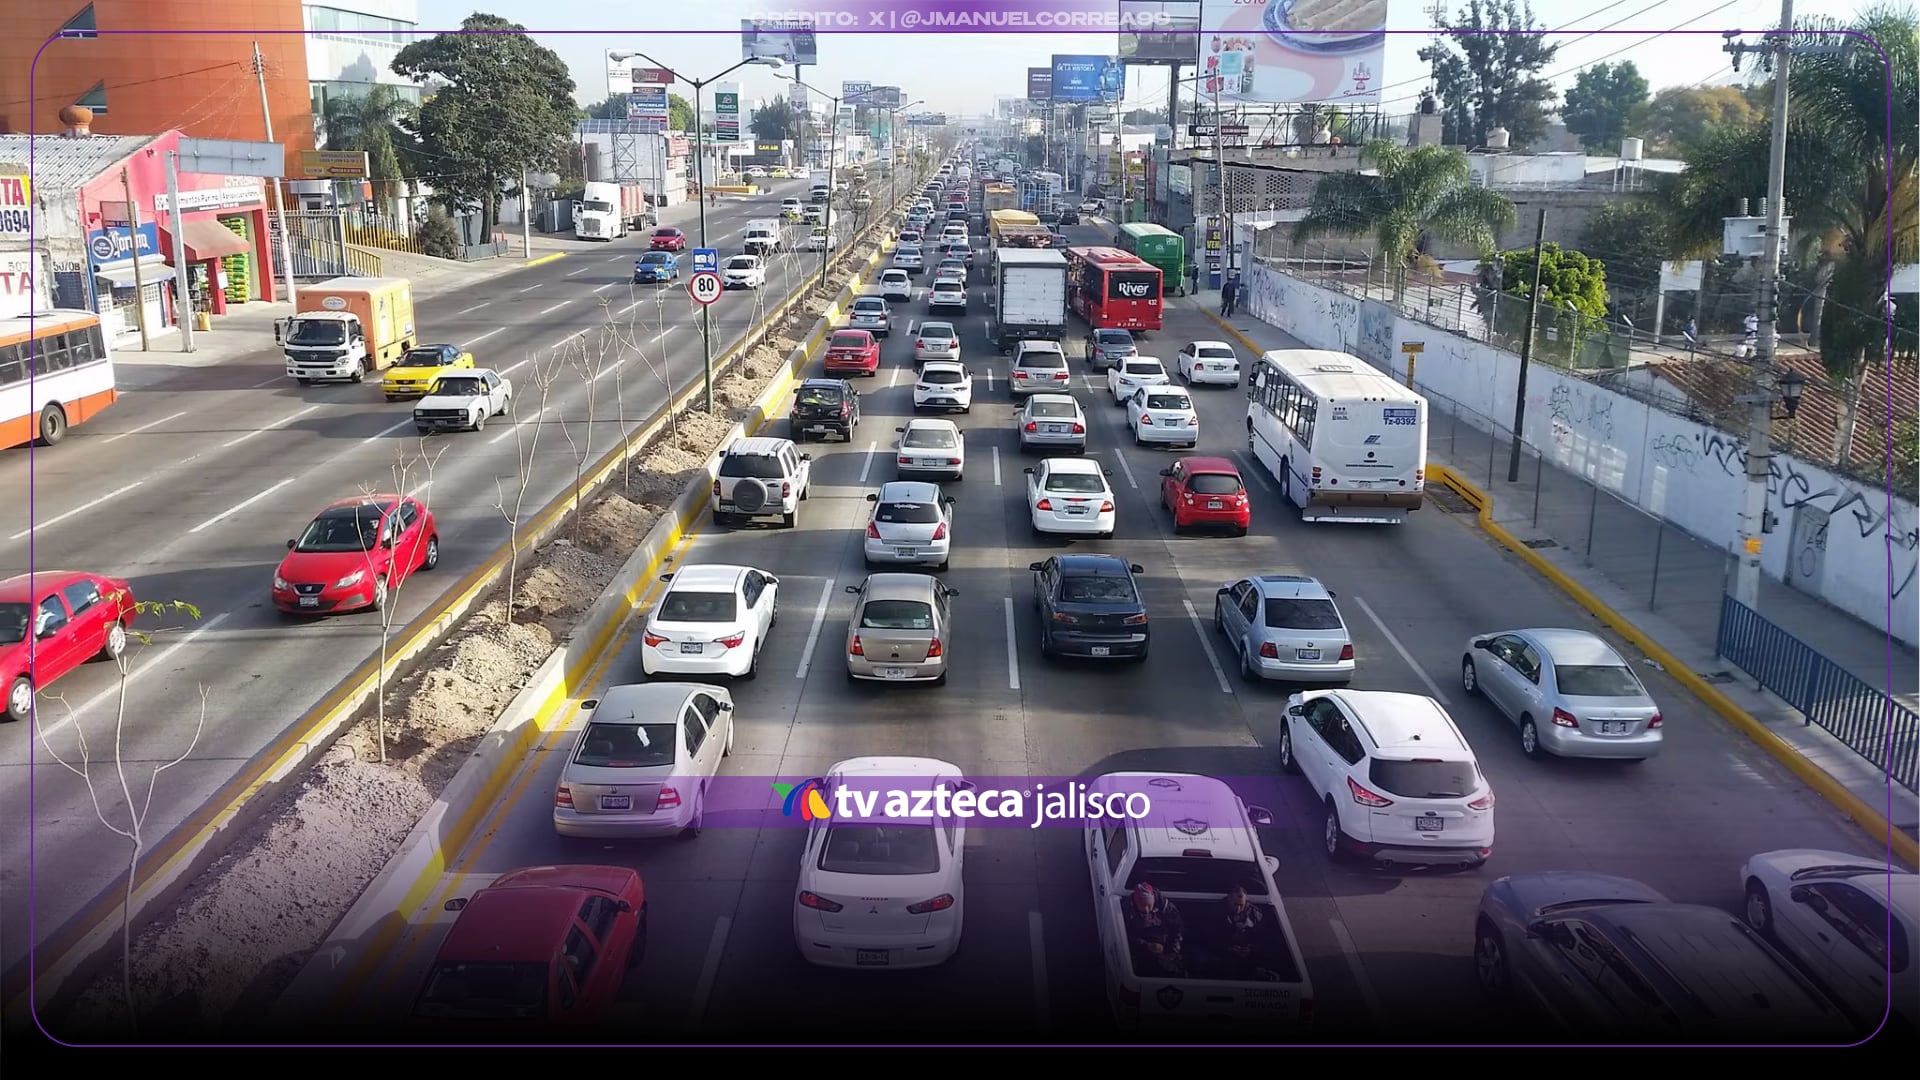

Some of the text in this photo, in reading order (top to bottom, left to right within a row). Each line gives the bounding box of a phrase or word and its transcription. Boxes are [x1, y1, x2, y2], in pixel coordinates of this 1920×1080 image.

[844, 84, 871, 92] RENTA
[698, 278, 714, 292] 80
[1119, 281, 1150, 297] River
[1383, 417, 1416, 426] Tz-0392
